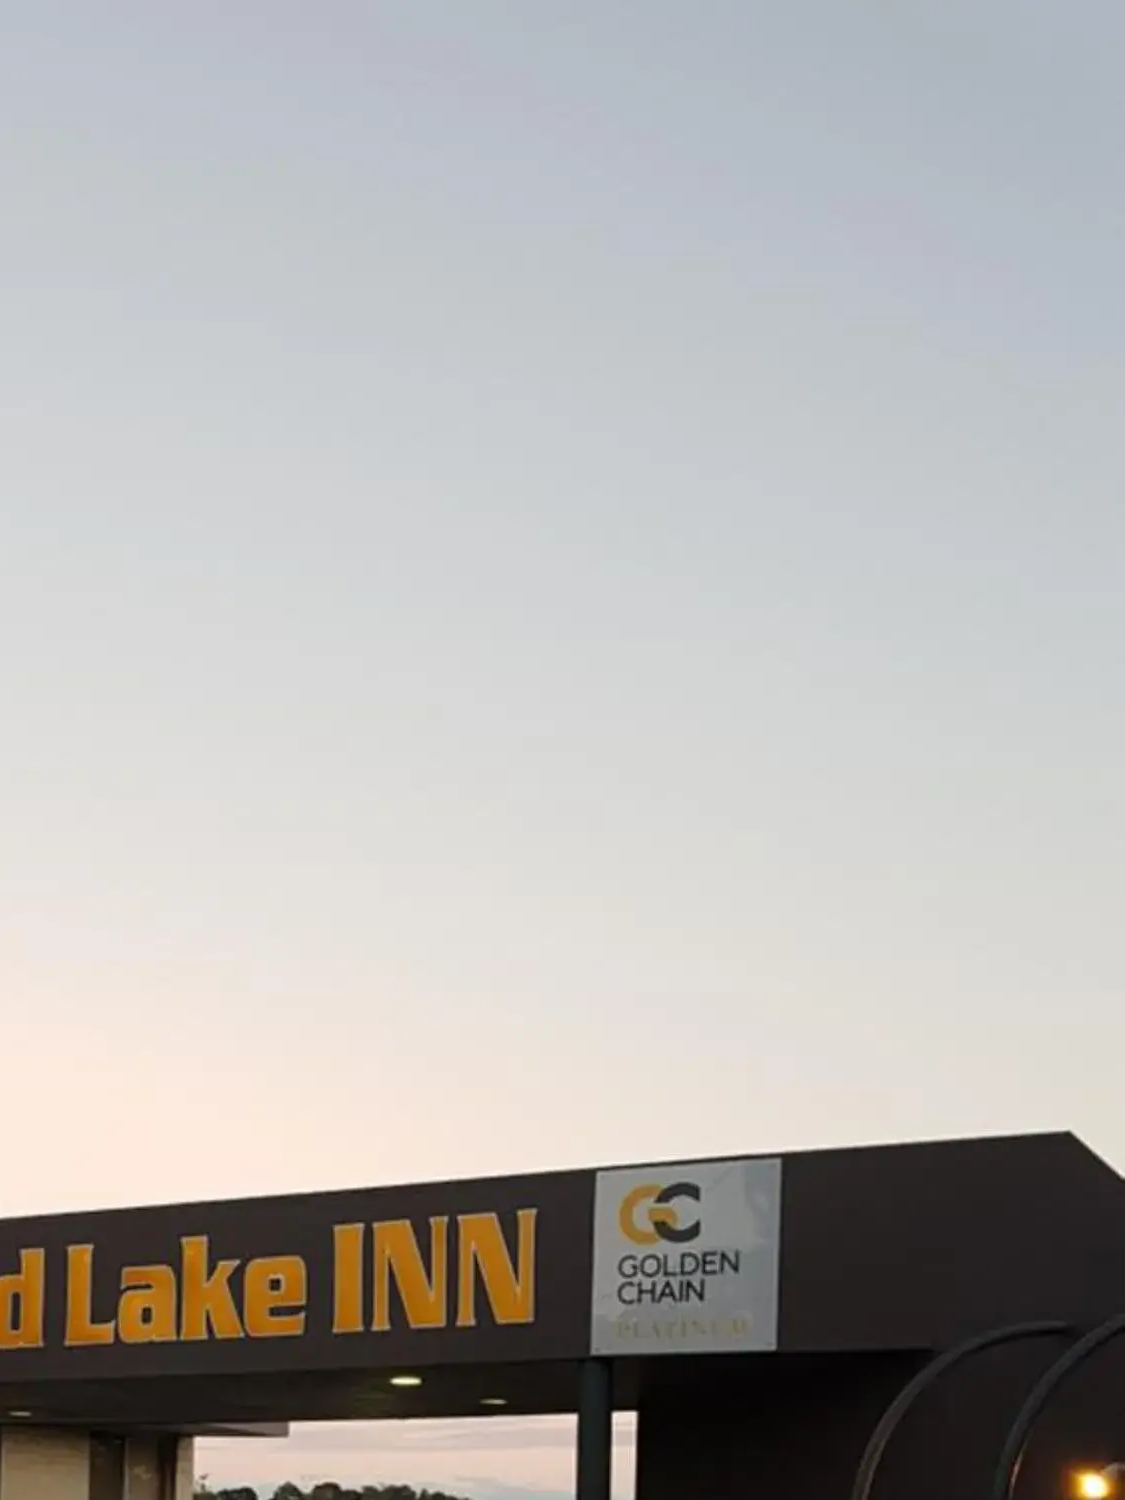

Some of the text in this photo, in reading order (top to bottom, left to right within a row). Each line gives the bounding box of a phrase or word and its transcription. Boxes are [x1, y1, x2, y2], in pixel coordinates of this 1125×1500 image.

[64, 1236, 307, 1346] Lake
[332, 1207, 537, 1333] INN
[617, 1251, 740, 1279] GOLDEN
[616, 1278, 706, 1305] CHAIN
